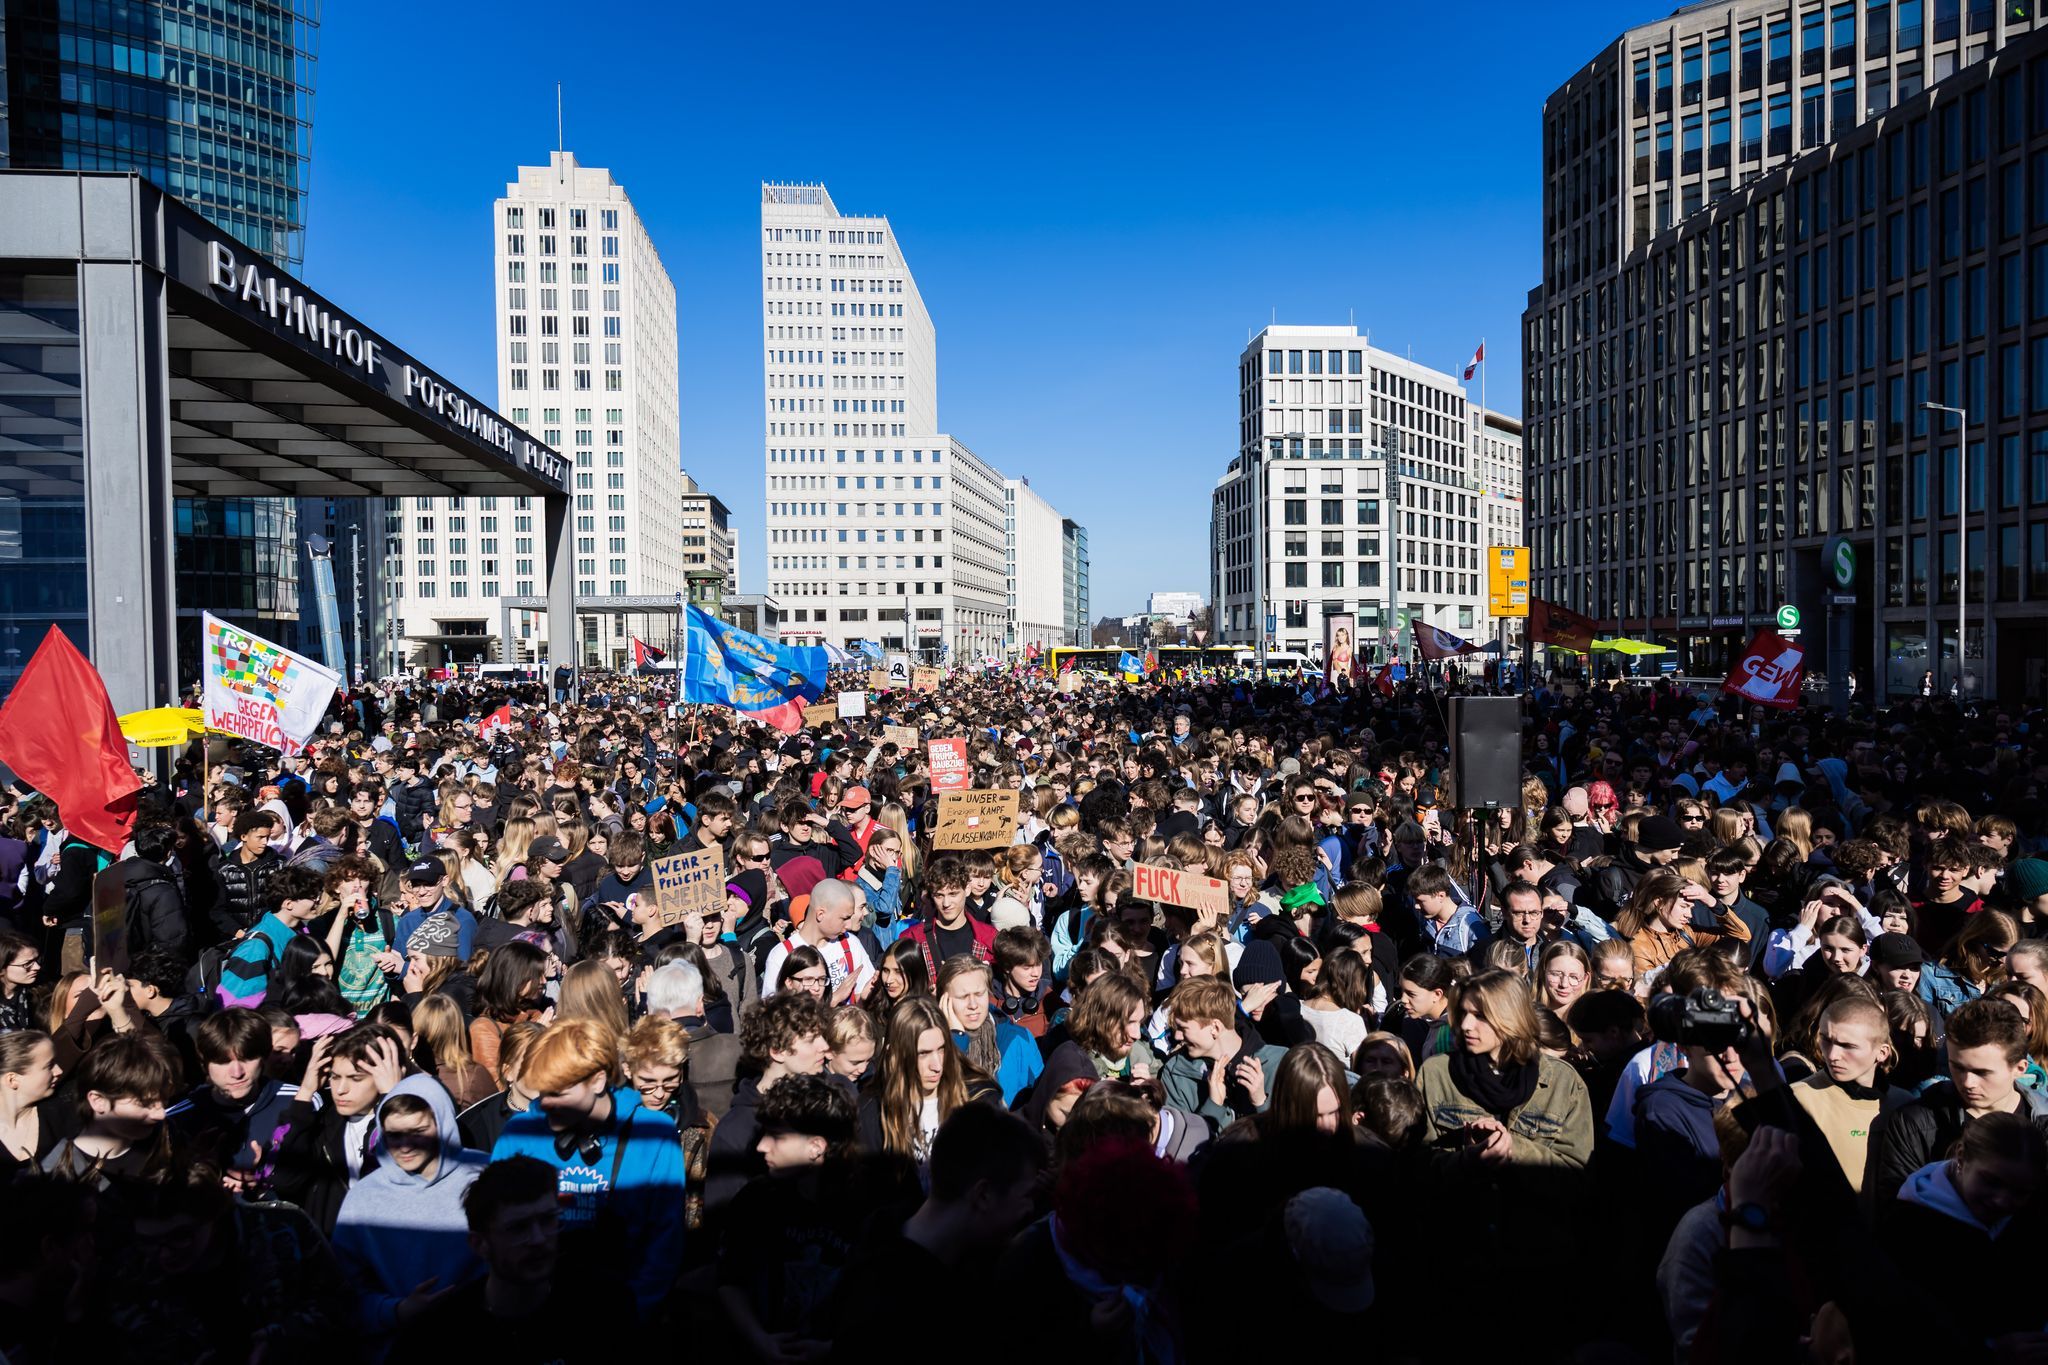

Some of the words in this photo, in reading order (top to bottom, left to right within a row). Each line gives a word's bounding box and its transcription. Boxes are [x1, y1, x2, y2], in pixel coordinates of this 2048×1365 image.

[207, 240, 382, 374] BAHNHOF
[403, 364, 514, 455] POTSDAMER
[523, 440, 563, 482] PLATZ
[1836, 541, 1853, 585] S
[1267, 617, 1274, 631] U
[1713, 617, 1725, 626] dean
[1729, 616, 1743, 625] david
[1782, 608, 1796, 626] S
[222, 631, 286, 668] Robert
[253, 662, 292, 693] Blum
[1743, 655, 1799, 689] GEW
[237, 697, 279, 723] GEGEN
[211, 708, 301, 756] WEHRPFLICHT
[930, 743, 953, 752] GEGEN
[931, 752, 959, 761] TRUMPS
[932, 759, 965, 769] RAUBZUG!
[966, 793, 998, 804] UNSER
[980, 806, 1005, 816] KAMPF
[655, 856, 711, 875] WEHR-
[661, 878, 721, 911] NEIN
[1136, 867, 1181, 905] FUCK
[559, 1181, 579, 1194] STILL
[580, 1183, 599, 1194] NOT
